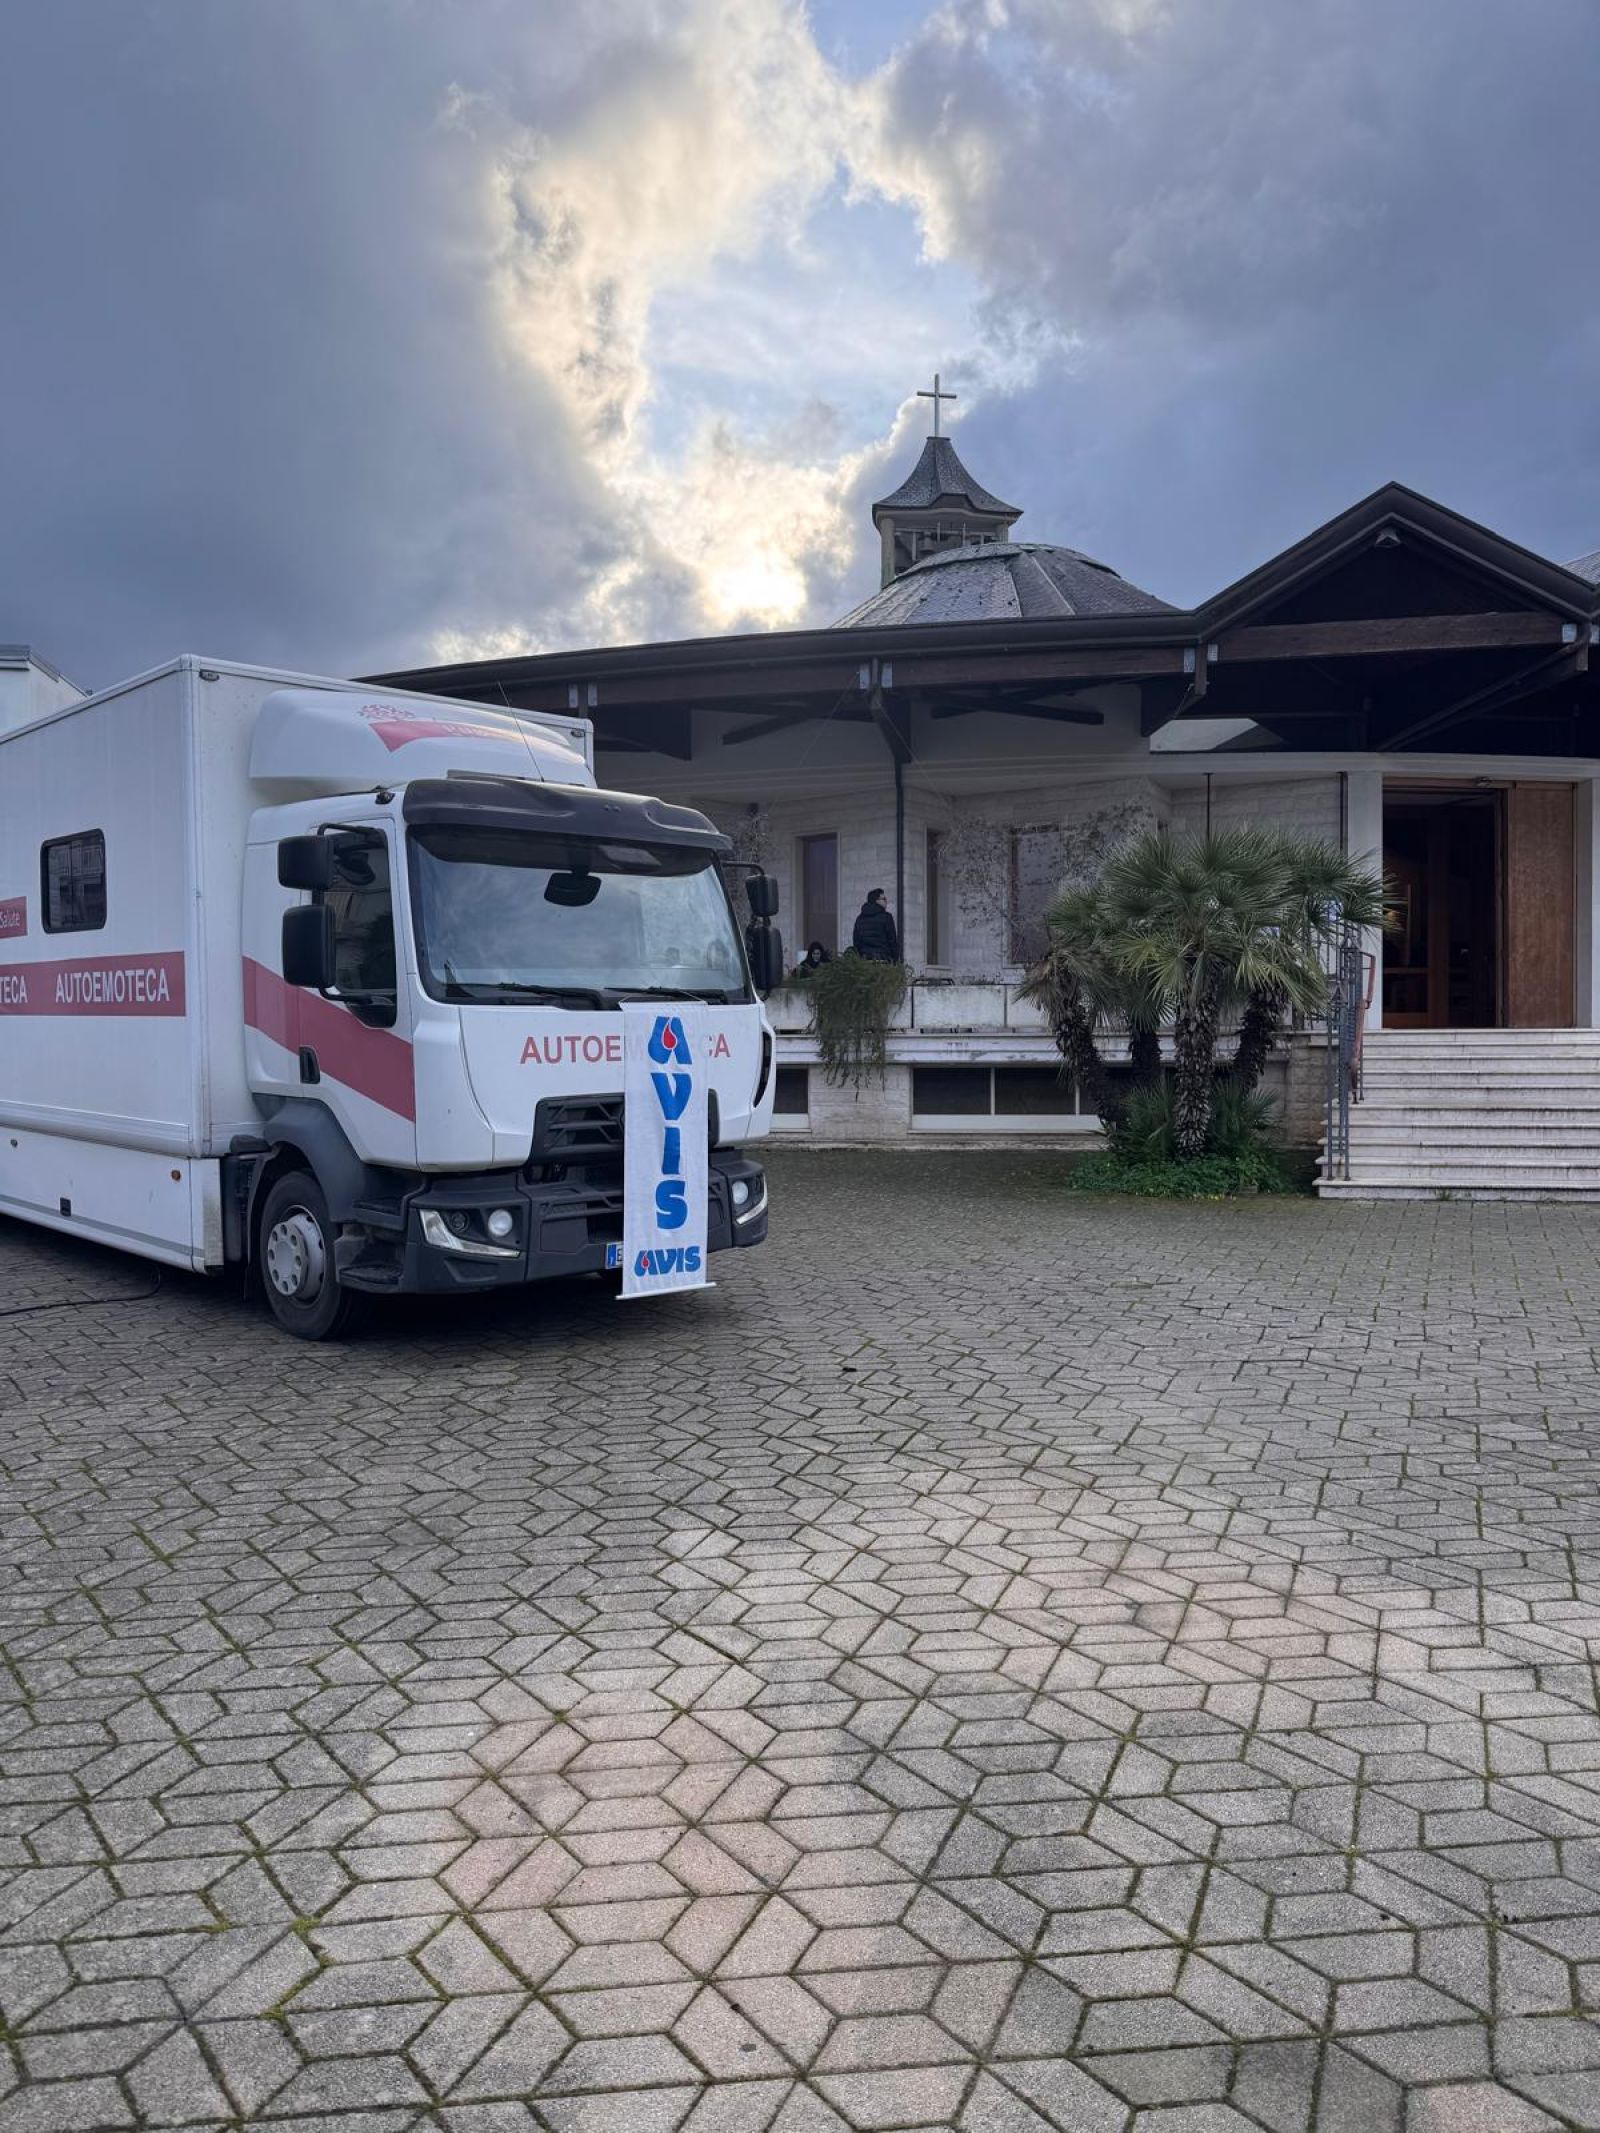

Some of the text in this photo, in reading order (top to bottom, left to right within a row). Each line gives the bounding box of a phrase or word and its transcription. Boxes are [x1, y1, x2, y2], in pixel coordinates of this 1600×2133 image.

[55, 967, 170, 1003] AUTOEMOTECA
[647, 1015, 693, 1230] AVIS
[634, 1245, 702, 1277] AVIS
